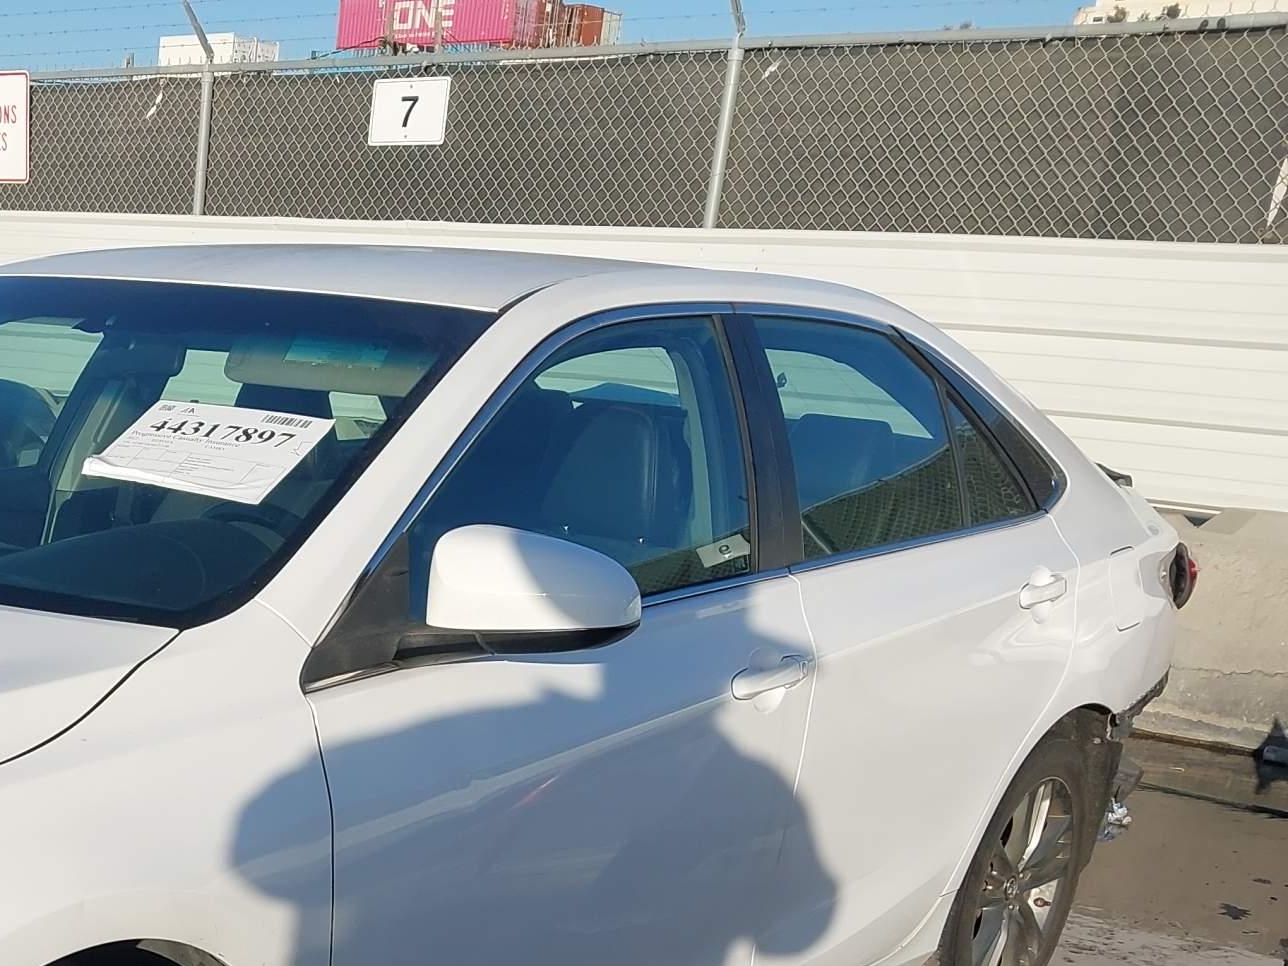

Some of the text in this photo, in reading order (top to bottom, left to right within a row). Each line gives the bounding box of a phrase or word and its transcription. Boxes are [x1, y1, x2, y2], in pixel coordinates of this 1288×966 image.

[393, 0, 455, 30] ONE
[401, 96, 419, 128] 7
[150, 418, 296, 448] 44317897
